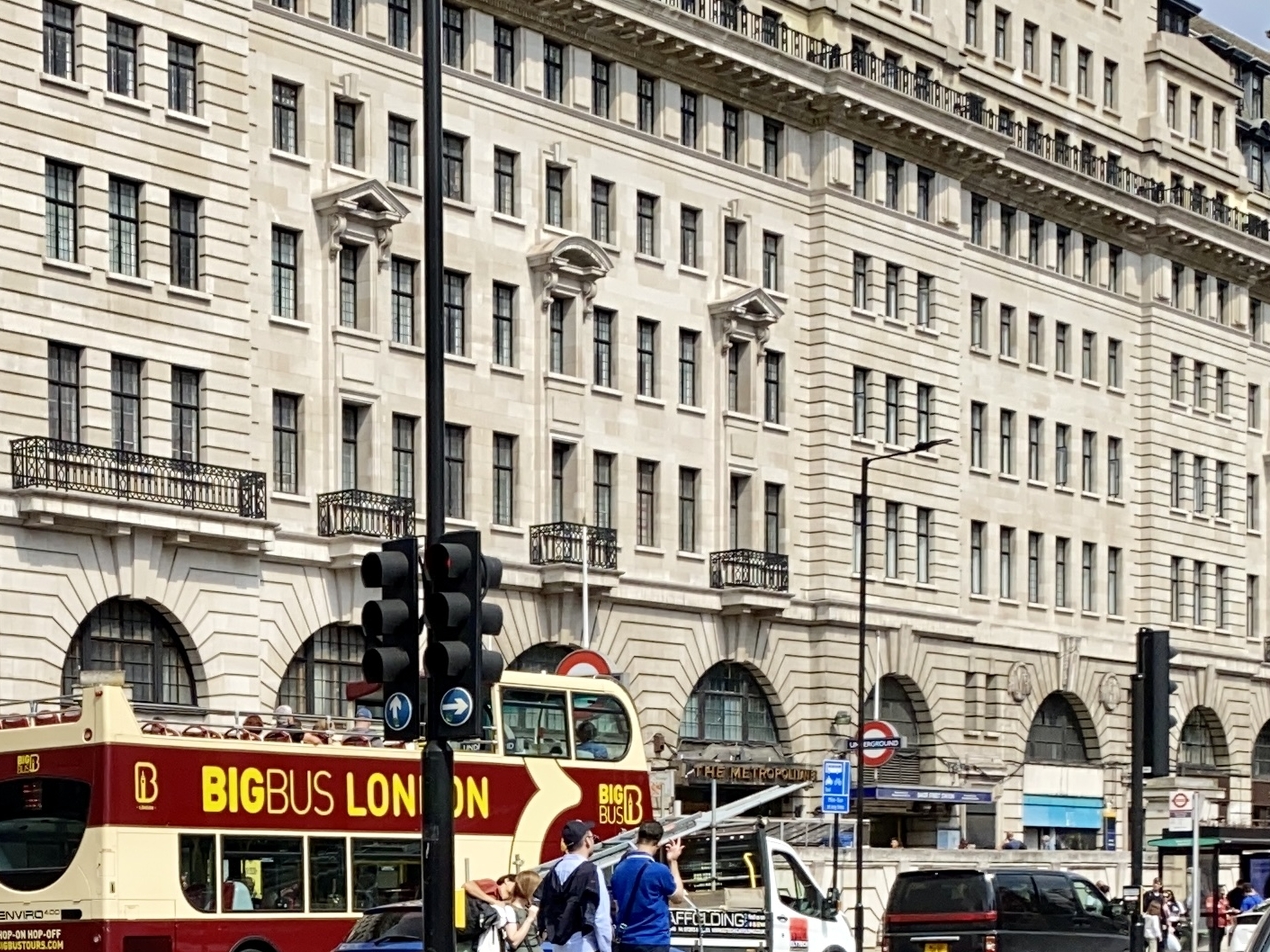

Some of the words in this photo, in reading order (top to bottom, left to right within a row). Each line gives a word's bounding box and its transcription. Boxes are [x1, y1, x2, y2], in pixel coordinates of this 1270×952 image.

[849, 740, 899, 748] UNERGROUND
[694, 764, 725, 778] THE
[730, 766, 810, 780] METROPOLITAN
[346, 772, 489, 818] LONN
[598, 783, 624, 804] BIG
[599, 806, 623, 825] BUS
[28, 928, 62, 939] HOP-OFF
